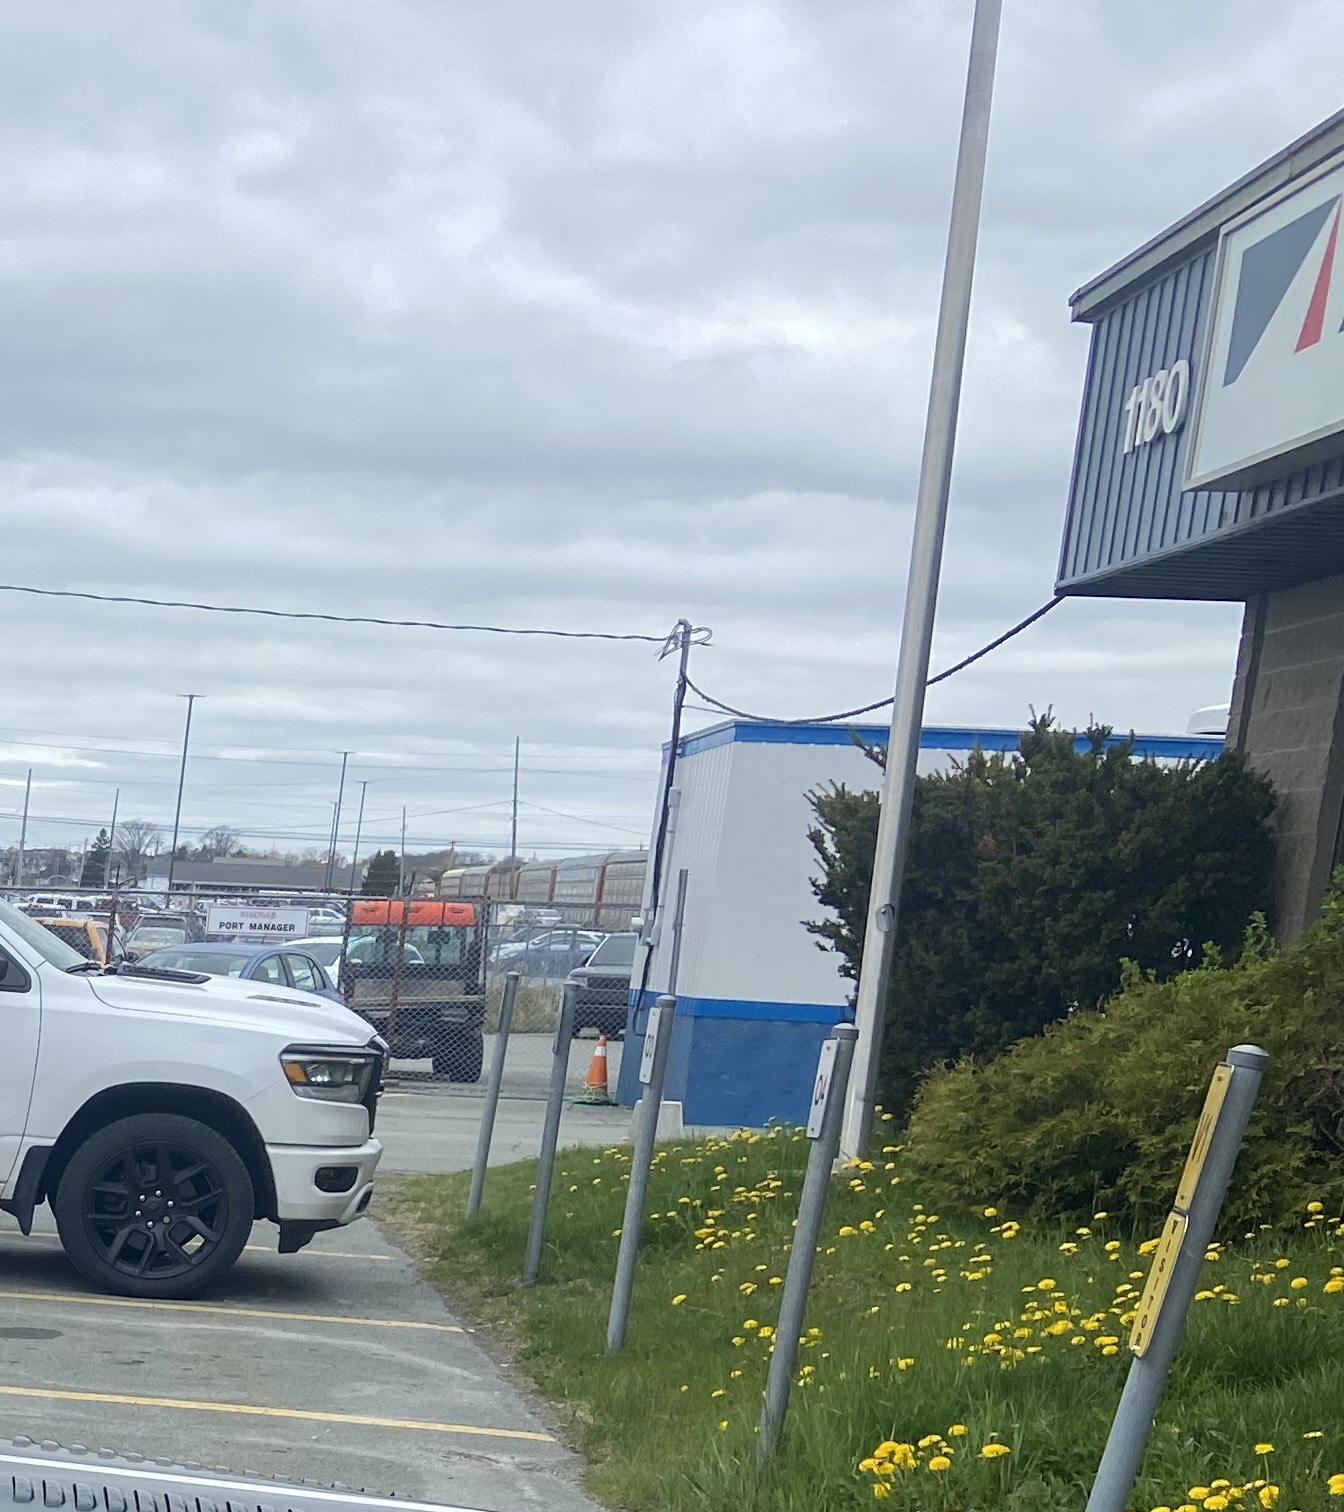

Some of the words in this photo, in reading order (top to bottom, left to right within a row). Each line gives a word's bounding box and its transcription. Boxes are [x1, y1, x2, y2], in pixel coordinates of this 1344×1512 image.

[1124, 359, 1190, 454] 1180
[218, 921, 245, 930] PORT
[248, 922, 296, 932] MANAGER
[240, 911, 277, 920] RESERVED
[1134, 1218, 1180, 1348] VISITOR
